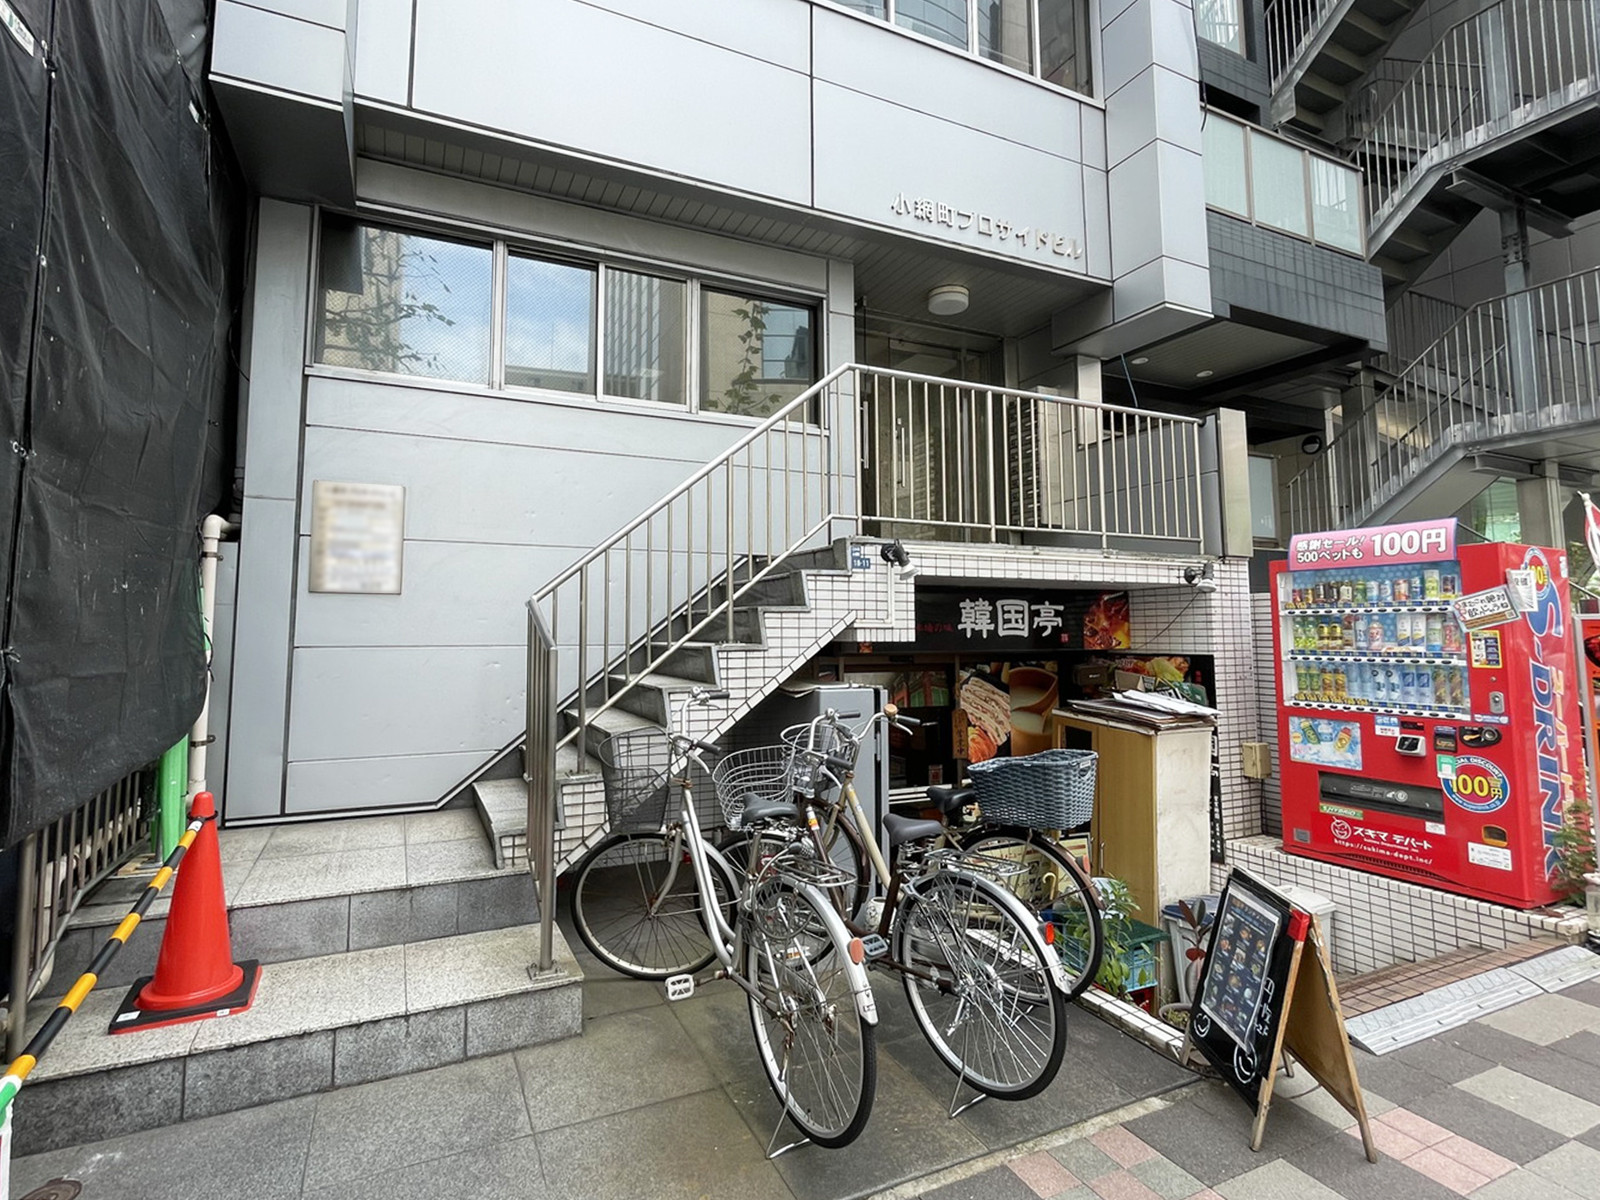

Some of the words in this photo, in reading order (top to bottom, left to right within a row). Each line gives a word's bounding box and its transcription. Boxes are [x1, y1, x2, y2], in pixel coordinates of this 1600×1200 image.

[891, 192, 1083, 260] 小網町プロサイドビル
[1296, 535, 1366, 551] 感謝セール!
[1297, 548, 1364, 563] 500ペットも
[1371, 527, 1447, 557] 100円
[957, 597, 1065, 639] 韓国亭
[1353, 826, 1389, 841] スキマ
[1392, 834, 1433, 850] デパート
